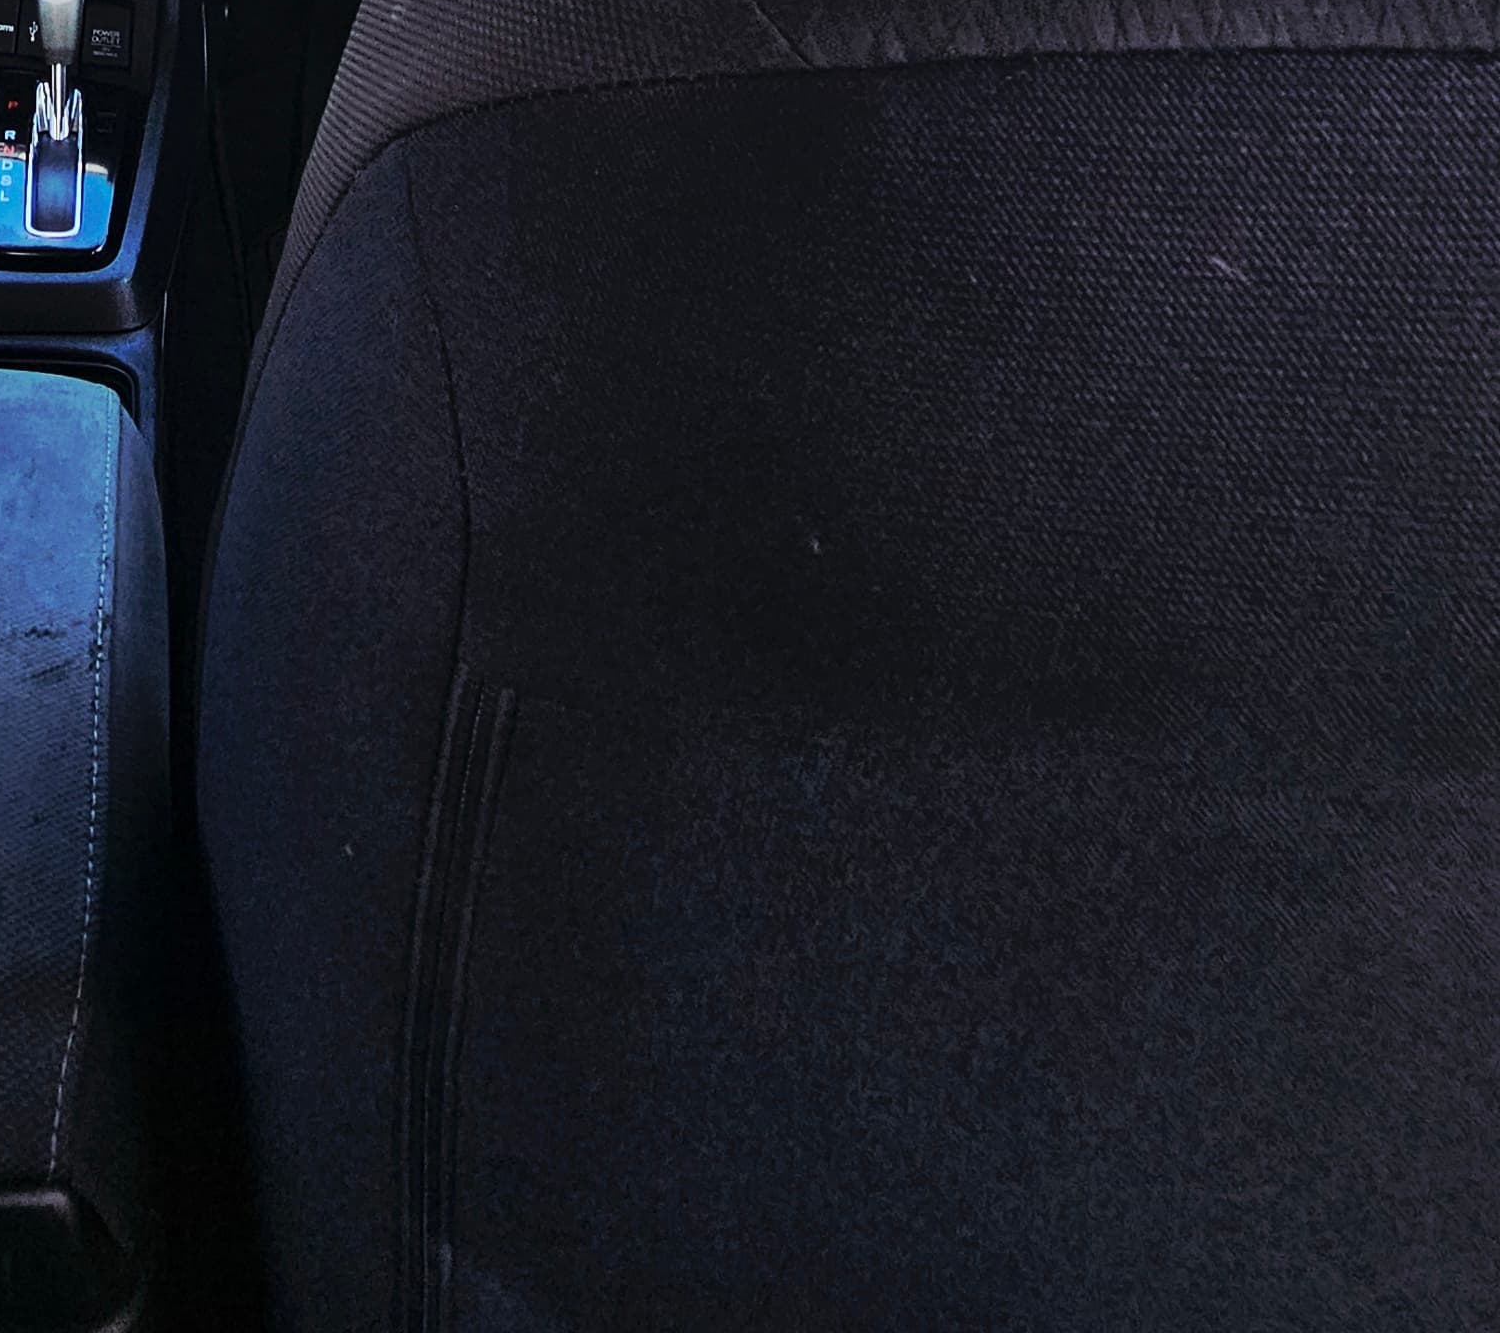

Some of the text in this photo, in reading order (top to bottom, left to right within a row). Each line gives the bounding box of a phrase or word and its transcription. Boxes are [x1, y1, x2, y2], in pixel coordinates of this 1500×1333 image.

[92, 29, 121, 37] POWER
[91, 36, 121, 44] OUTLET
[7, 101, 19, 110] P
[4, 130, 16, 140] R
[3, 144, 15, 154] N
[1, 159, 14, 171] D
[0, 175, 12, 186] S
[0, 190, 10, 202] L
